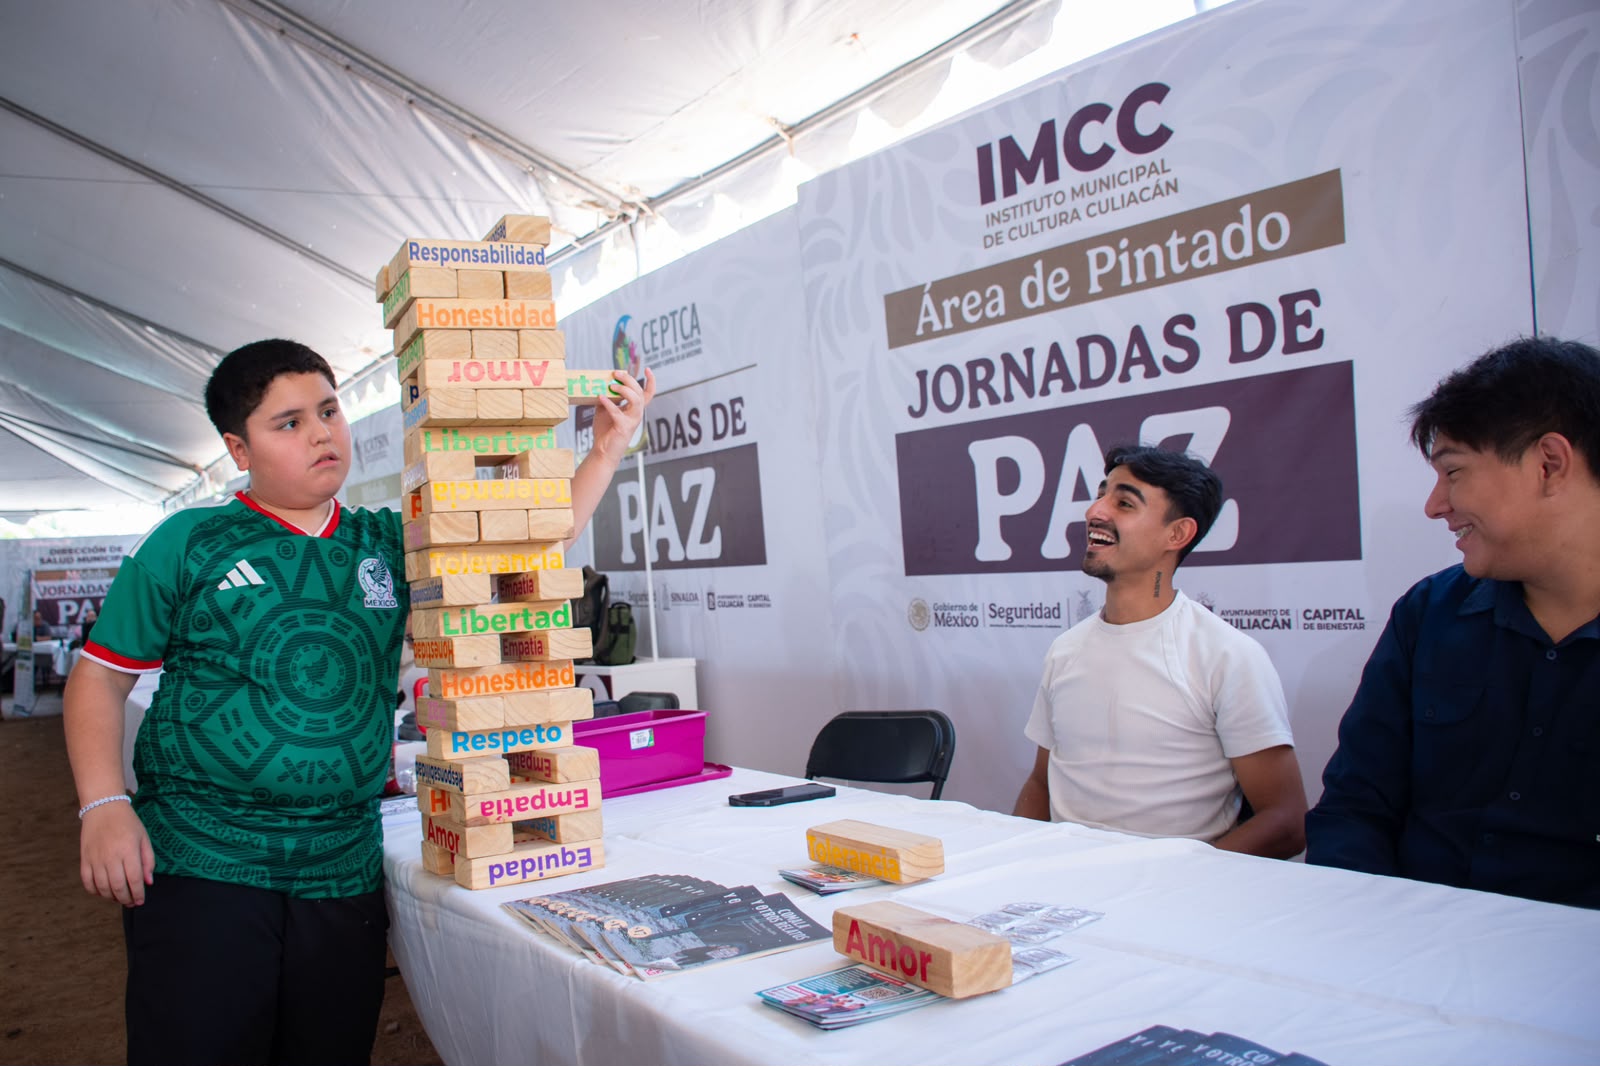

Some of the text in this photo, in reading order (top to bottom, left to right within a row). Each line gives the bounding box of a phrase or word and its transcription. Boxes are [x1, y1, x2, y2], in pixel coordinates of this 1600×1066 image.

[976, 82, 1174, 205] IMCC
[985, 158, 1171, 228] INSTITUTO MUNICIPAL
[983, 178, 1179, 249] DE CULTURA CULIACÁN
[409, 241, 545, 267] Responsabilidad
[915, 203, 1291, 336] Área de Pintado
[417, 302, 556, 328] Honestidad
[641, 302, 701, 354] CEPTCA
[907, 288, 1325, 420] JORNADAS DE
[447, 360, 549, 387] Amor
[710, 396, 747, 441] DE
[424, 428, 554, 454] Libertad
[433, 479, 572, 509] Tolerancia
[617, 467, 722, 564] PAZ
[429, 546, 563, 575] Tolerancia
[500, 574, 535, 600] Empatía
[442, 603, 569, 636] Libertad
[933, 603, 978, 612] Gobierno de
[934, 612, 979, 628] México
[988, 602, 1061, 624] Seguridad
[1220, 609, 1278, 617] AYUNTAMIENTO
[1302, 608, 1365, 621] CAPITAL
[1303, 622, 1366, 631] DE BIENESTAR
[503, 635, 543, 661] Empatía
[441, 660, 574, 697] Honestidad
[451, 724, 562, 753] Respeto
[480, 788, 588, 821] Empatía
[427, 817, 460, 853] Amor
[488, 848, 592, 885] Equidad
[806, 834, 901, 881] Tolerancia
[846, 919, 932, 983] Amor
